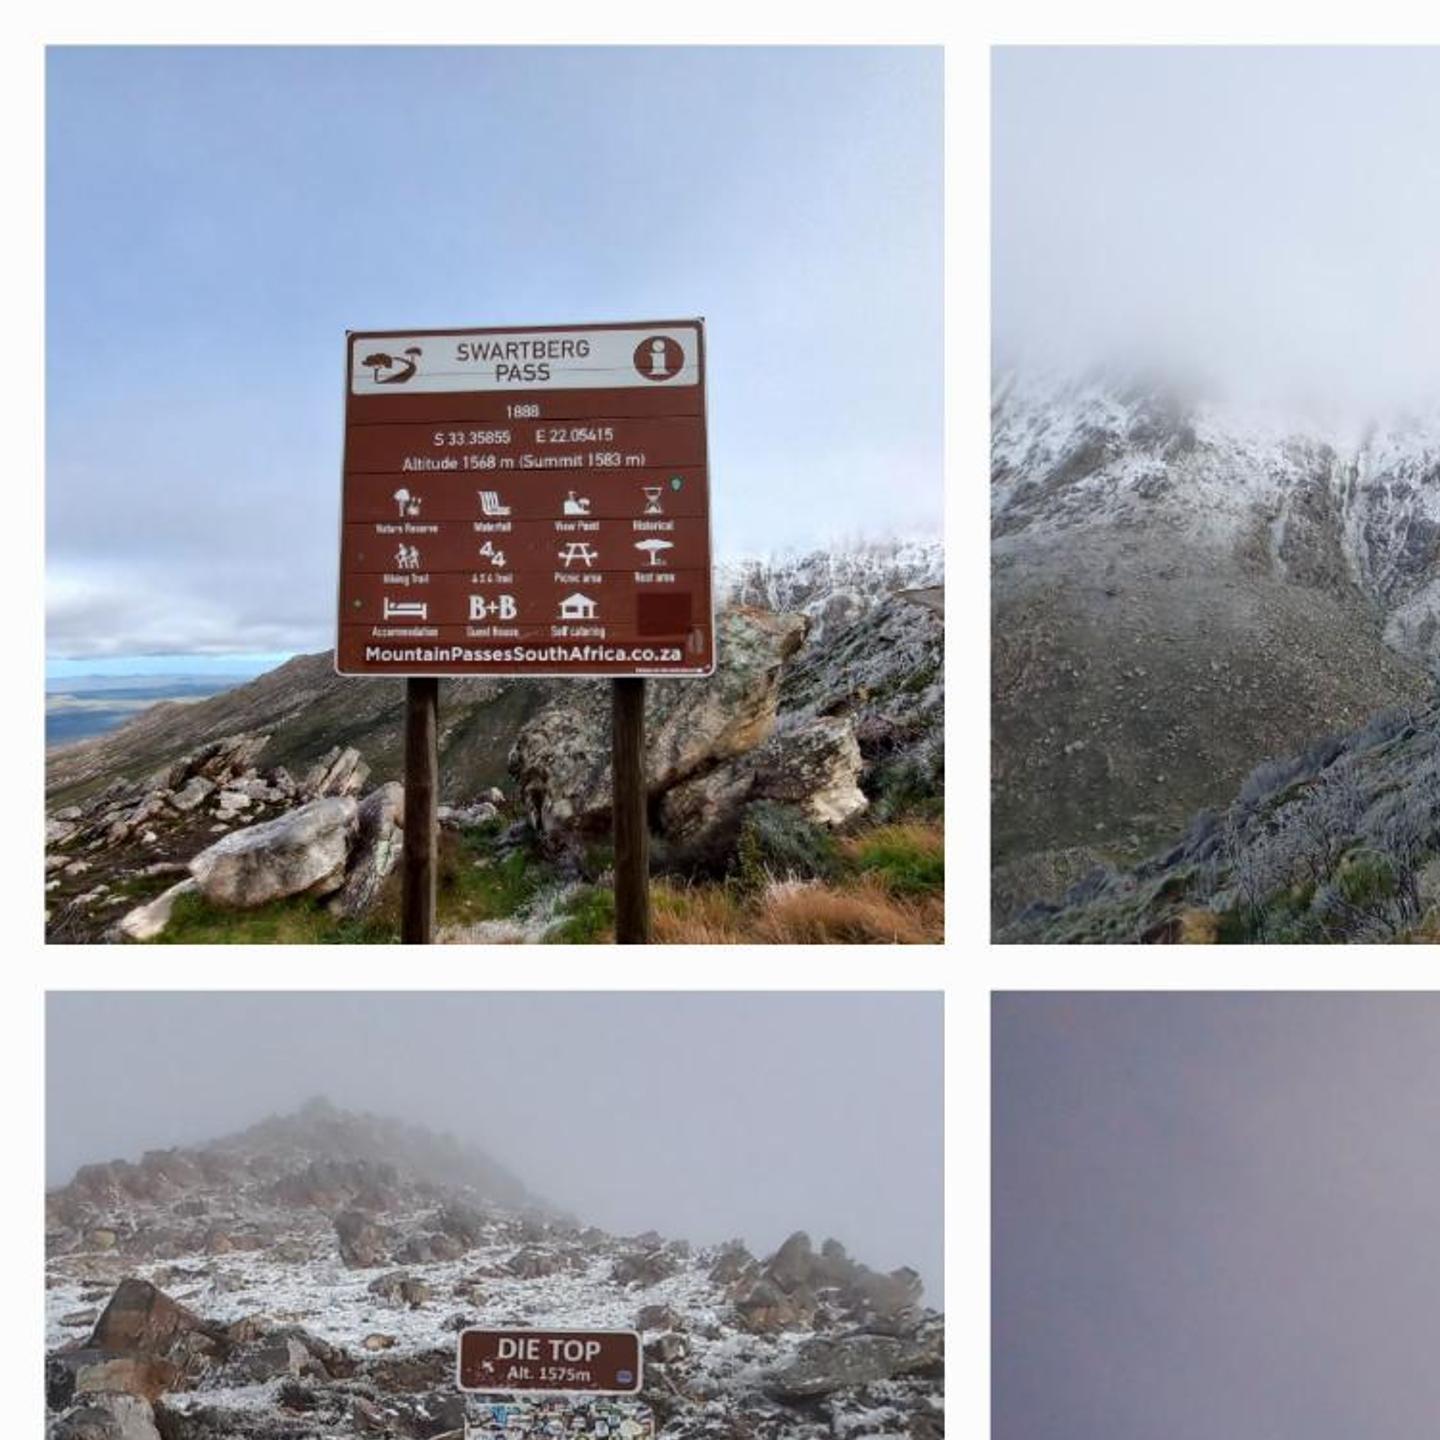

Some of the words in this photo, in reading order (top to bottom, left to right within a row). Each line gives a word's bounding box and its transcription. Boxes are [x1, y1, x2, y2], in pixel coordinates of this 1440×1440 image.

[456, 339, 590, 362] SWARTBERG
[495, 363, 551, 382] PASS
[506, 405, 539, 420] 1888
[433, 433, 444, 447] S
[536, 429, 546, 443] E
[402, 456, 457, 472] Altitude
[463, 456, 496, 470] 1568
[500, 458, 514, 470] m
[519, 453, 582, 470] (Summit
[588, 453, 621, 467] 1583
[626, 453, 646, 468] m)
[469, 595, 518, 620] B+B
[365, 645, 682, 663] MountainPassesSouthAfrica.co.za
[498, 1338, 540, 1361] DIE
[548, 1339, 601, 1362] TOP
[507, 1366, 534, 1381] Alt.
[539, 1366, 591, 1382] 1575m
